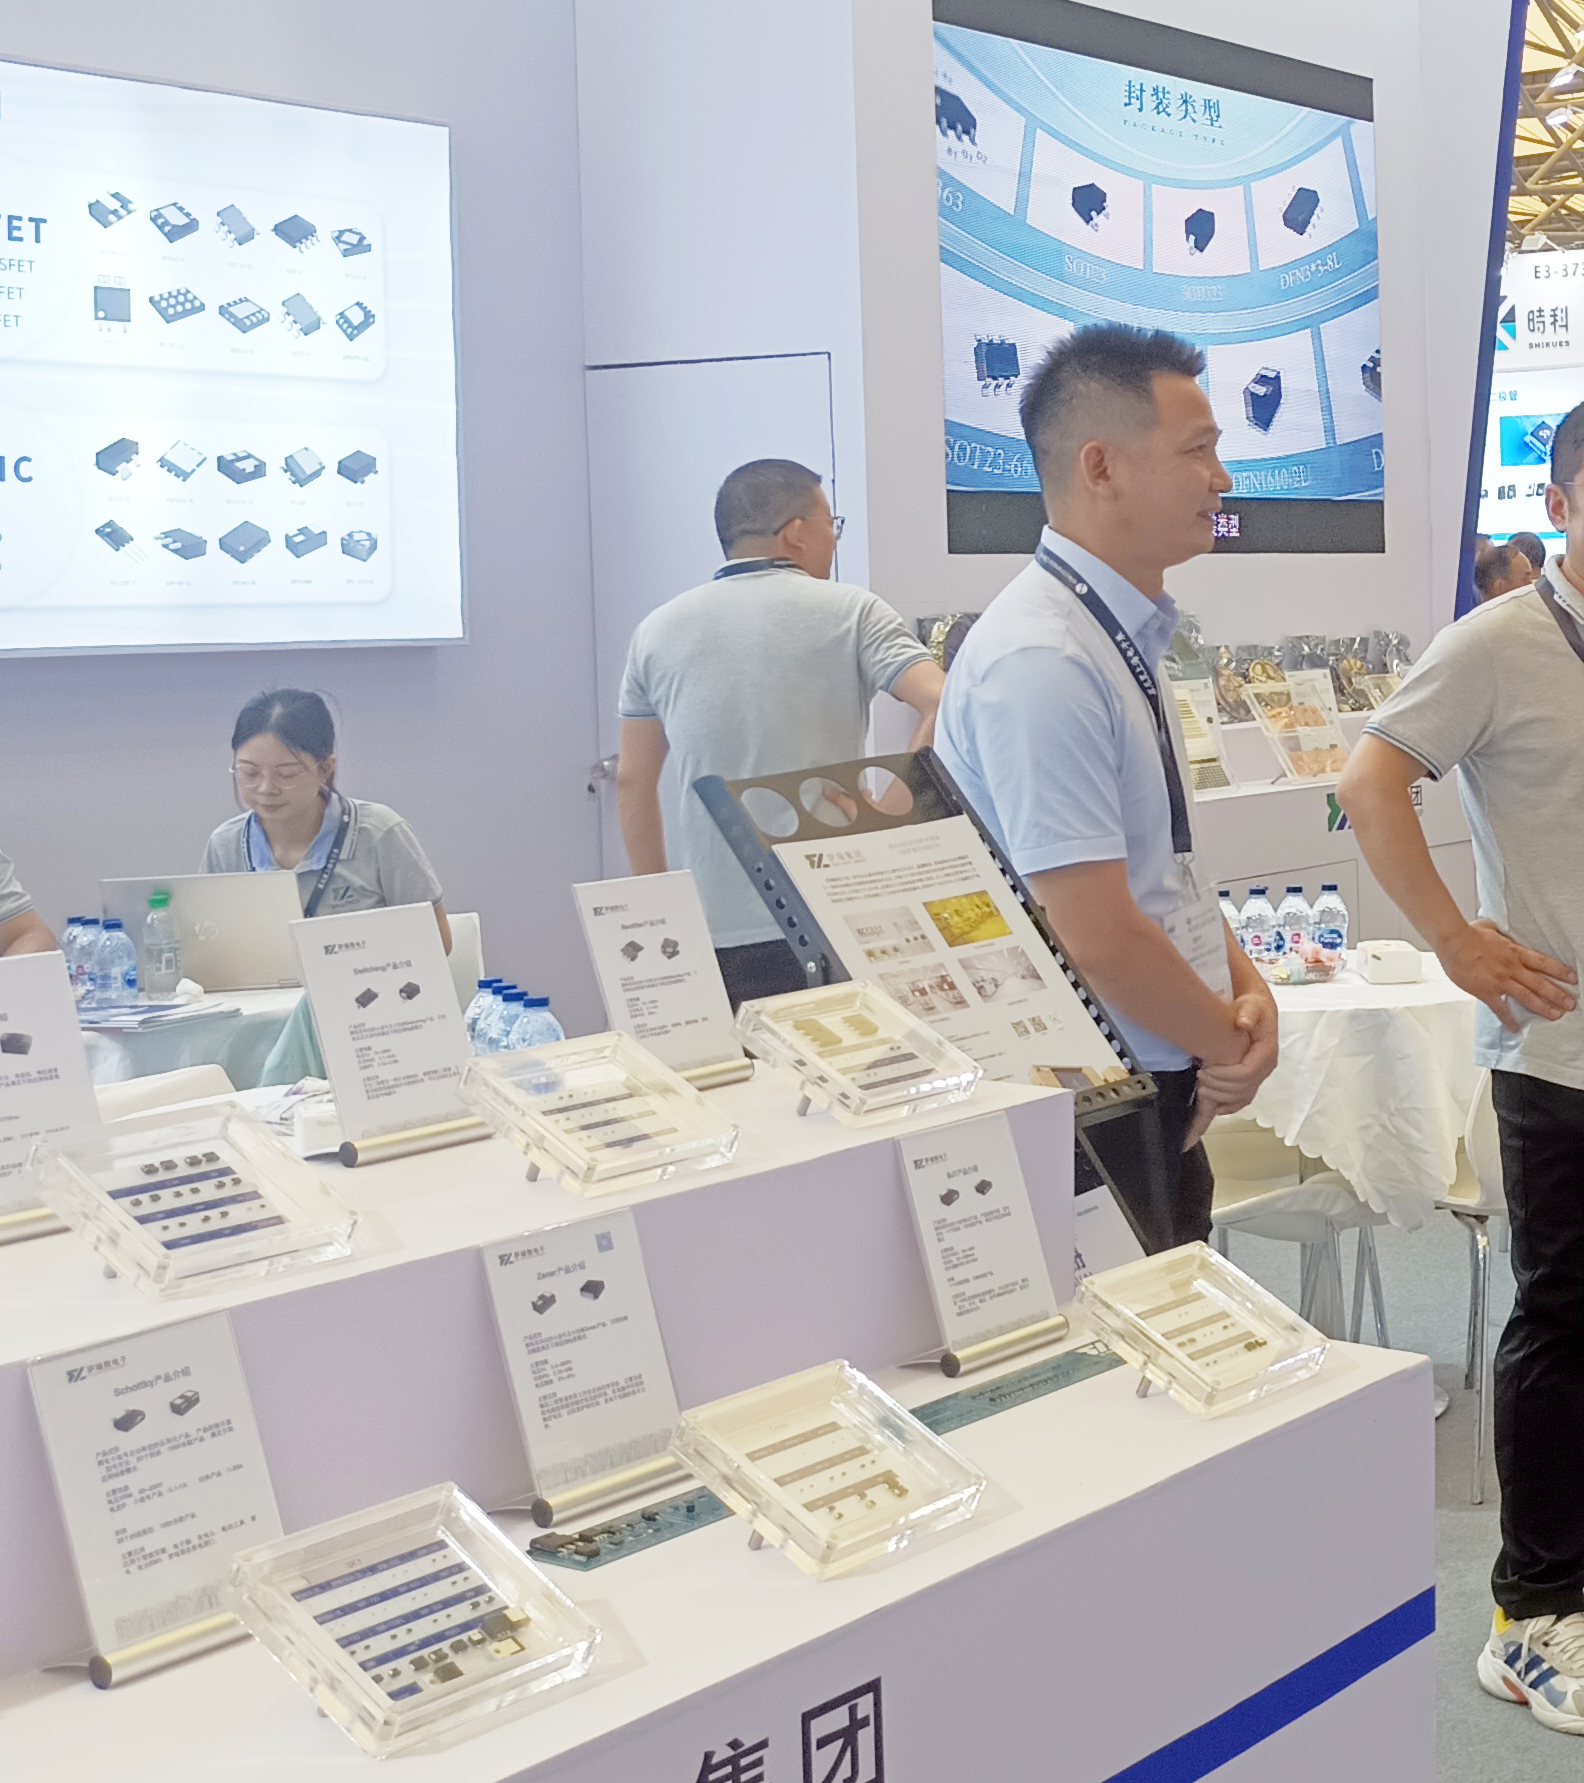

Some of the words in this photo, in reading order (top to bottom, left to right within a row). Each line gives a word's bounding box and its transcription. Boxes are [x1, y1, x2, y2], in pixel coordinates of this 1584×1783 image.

[1123, 79, 1223, 129] 封装类型
[0, 213, 47, 244] ET
[1527, 305, 1569, 335] 時科
[1528, 340, 1570, 350] SHIKUES
[112, 1365, 192, 1400] Schottky产品介绍
